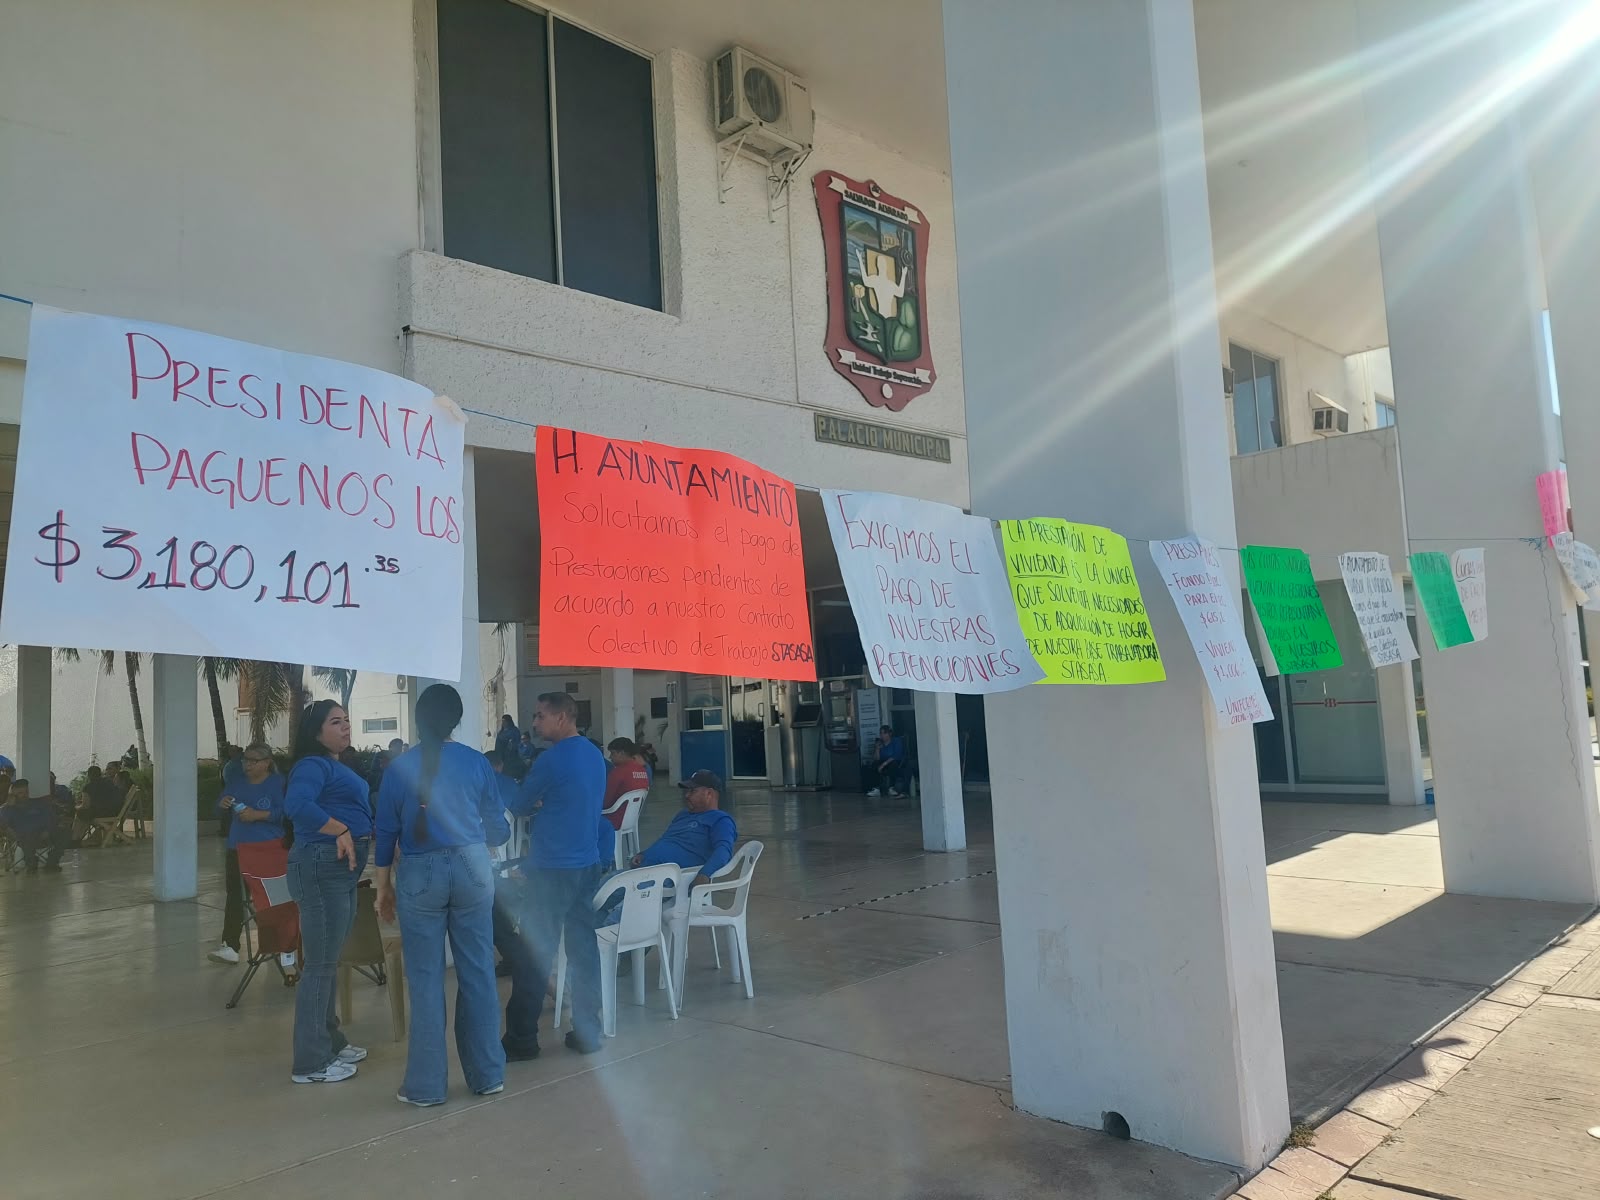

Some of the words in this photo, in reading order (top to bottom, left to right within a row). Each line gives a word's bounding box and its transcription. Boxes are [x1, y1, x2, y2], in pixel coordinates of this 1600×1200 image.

[844, 189, 877, 210] SALVADOR
[125, 332, 446, 469] PRESIDENTA
[818, 415, 878, 447] PALACIO
[883, 428, 950, 459] MUNICIPAL
[131, 431, 396, 529] PAGUENOS
[416, 485, 462, 544] LOS
[552, 428, 584, 475] H.
[596, 442, 794, 527] AYUNTAMIENTO
[563, 491, 699, 540] Solicitamos
[713, 518, 729, 547] el
[741, 526, 776, 566] pago
[782, 529, 801, 558] de
[837, 493, 941, 564] EXIGIMOS
[949, 539, 980, 575] EL
[1006, 520, 1026, 543] LA
[1093, 535, 1108, 556] DE
[549, 546, 670, 584] Prestaciones
[770, 580, 791, 598] de
[875, 564, 922, 613] PAGO
[929, 578, 956, 609] DE
[1010, 553, 1070, 577] VIVIENDA
[1085, 561, 1101, 585] LA
[1103, 559, 1136, 587] ÚNICA
[553, 589, 635, 616] acuerdo
[647, 601, 658, 617] a
[665, 597, 726, 618] nuestro
[737, 602, 796, 631] Contrato
[1016, 583, 1046, 609] QUE
[587, 625, 679, 654] Colectivo
[689, 632, 714, 656] de
[713, 635, 769, 667] Trabajo
[770, 641, 814, 663] STASASA
[887, 613, 996, 646] NUESTRAS
[1033, 611, 1052, 632] DE
[1102, 619, 1116, 637] DE
[1117, 621, 1152, 640] HOGAR
[872, 643, 1021, 683] RETENCIONES
[1026, 638, 1043, 656] DE
[1044, 638, 1083, 661] NUESTRA
[1104, 642, 1160, 663] TRABAJADORA
